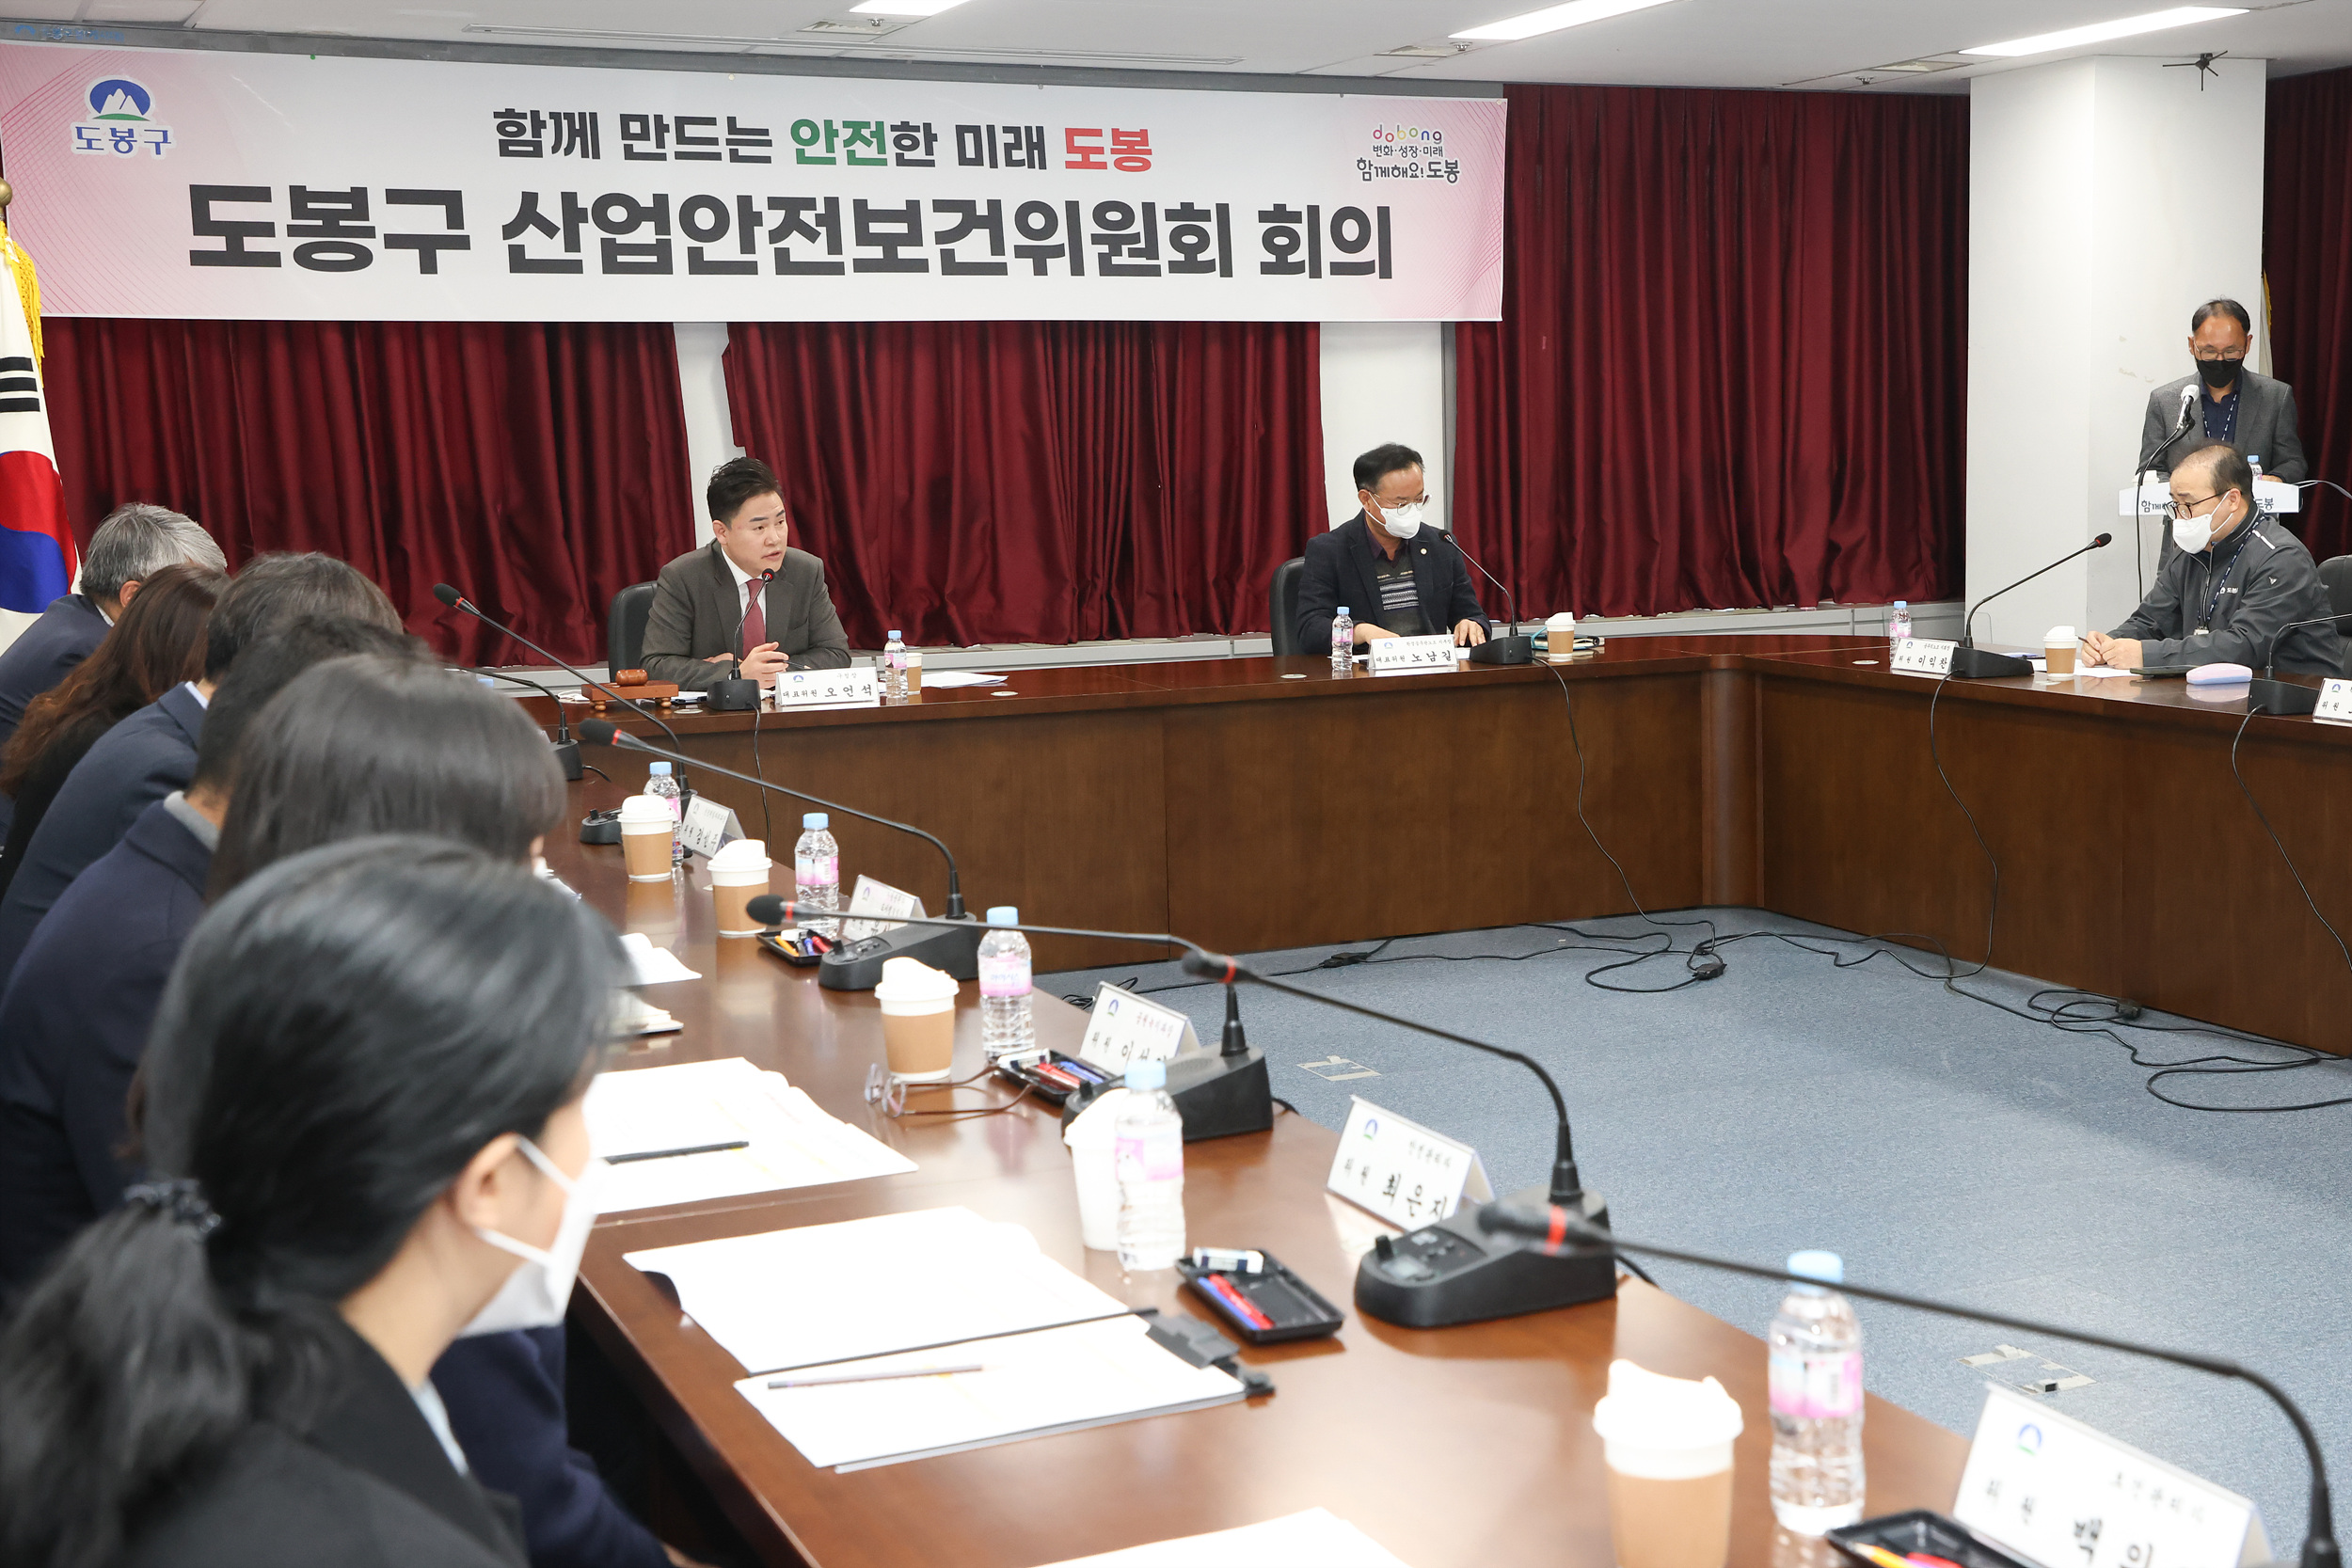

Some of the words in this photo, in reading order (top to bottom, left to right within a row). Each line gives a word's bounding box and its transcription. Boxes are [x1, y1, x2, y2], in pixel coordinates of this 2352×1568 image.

[75, 127, 171, 155] 도봉구
[494, 108, 601, 160] 함께
[620, 114, 773, 164] 만드는
[790, 119, 938, 167] 안전한
[956, 124, 1047, 170] 미래
[1064, 127, 1152, 172] 도봉
[1373, 124, 1442, 144] dobong
[1357, 157, 1424, 182] 함께해요!
[1426, 160, 1460, 183] 도봉
[188, 183, 471, 275] 도봉구
[501, 191, 1233, 278] 산업안전보건위원회
[1258, 203, 1393, 279] 회의
[1411, 650, 1452, 663] 노남길
[824, 684, 872, 698] 오언석
